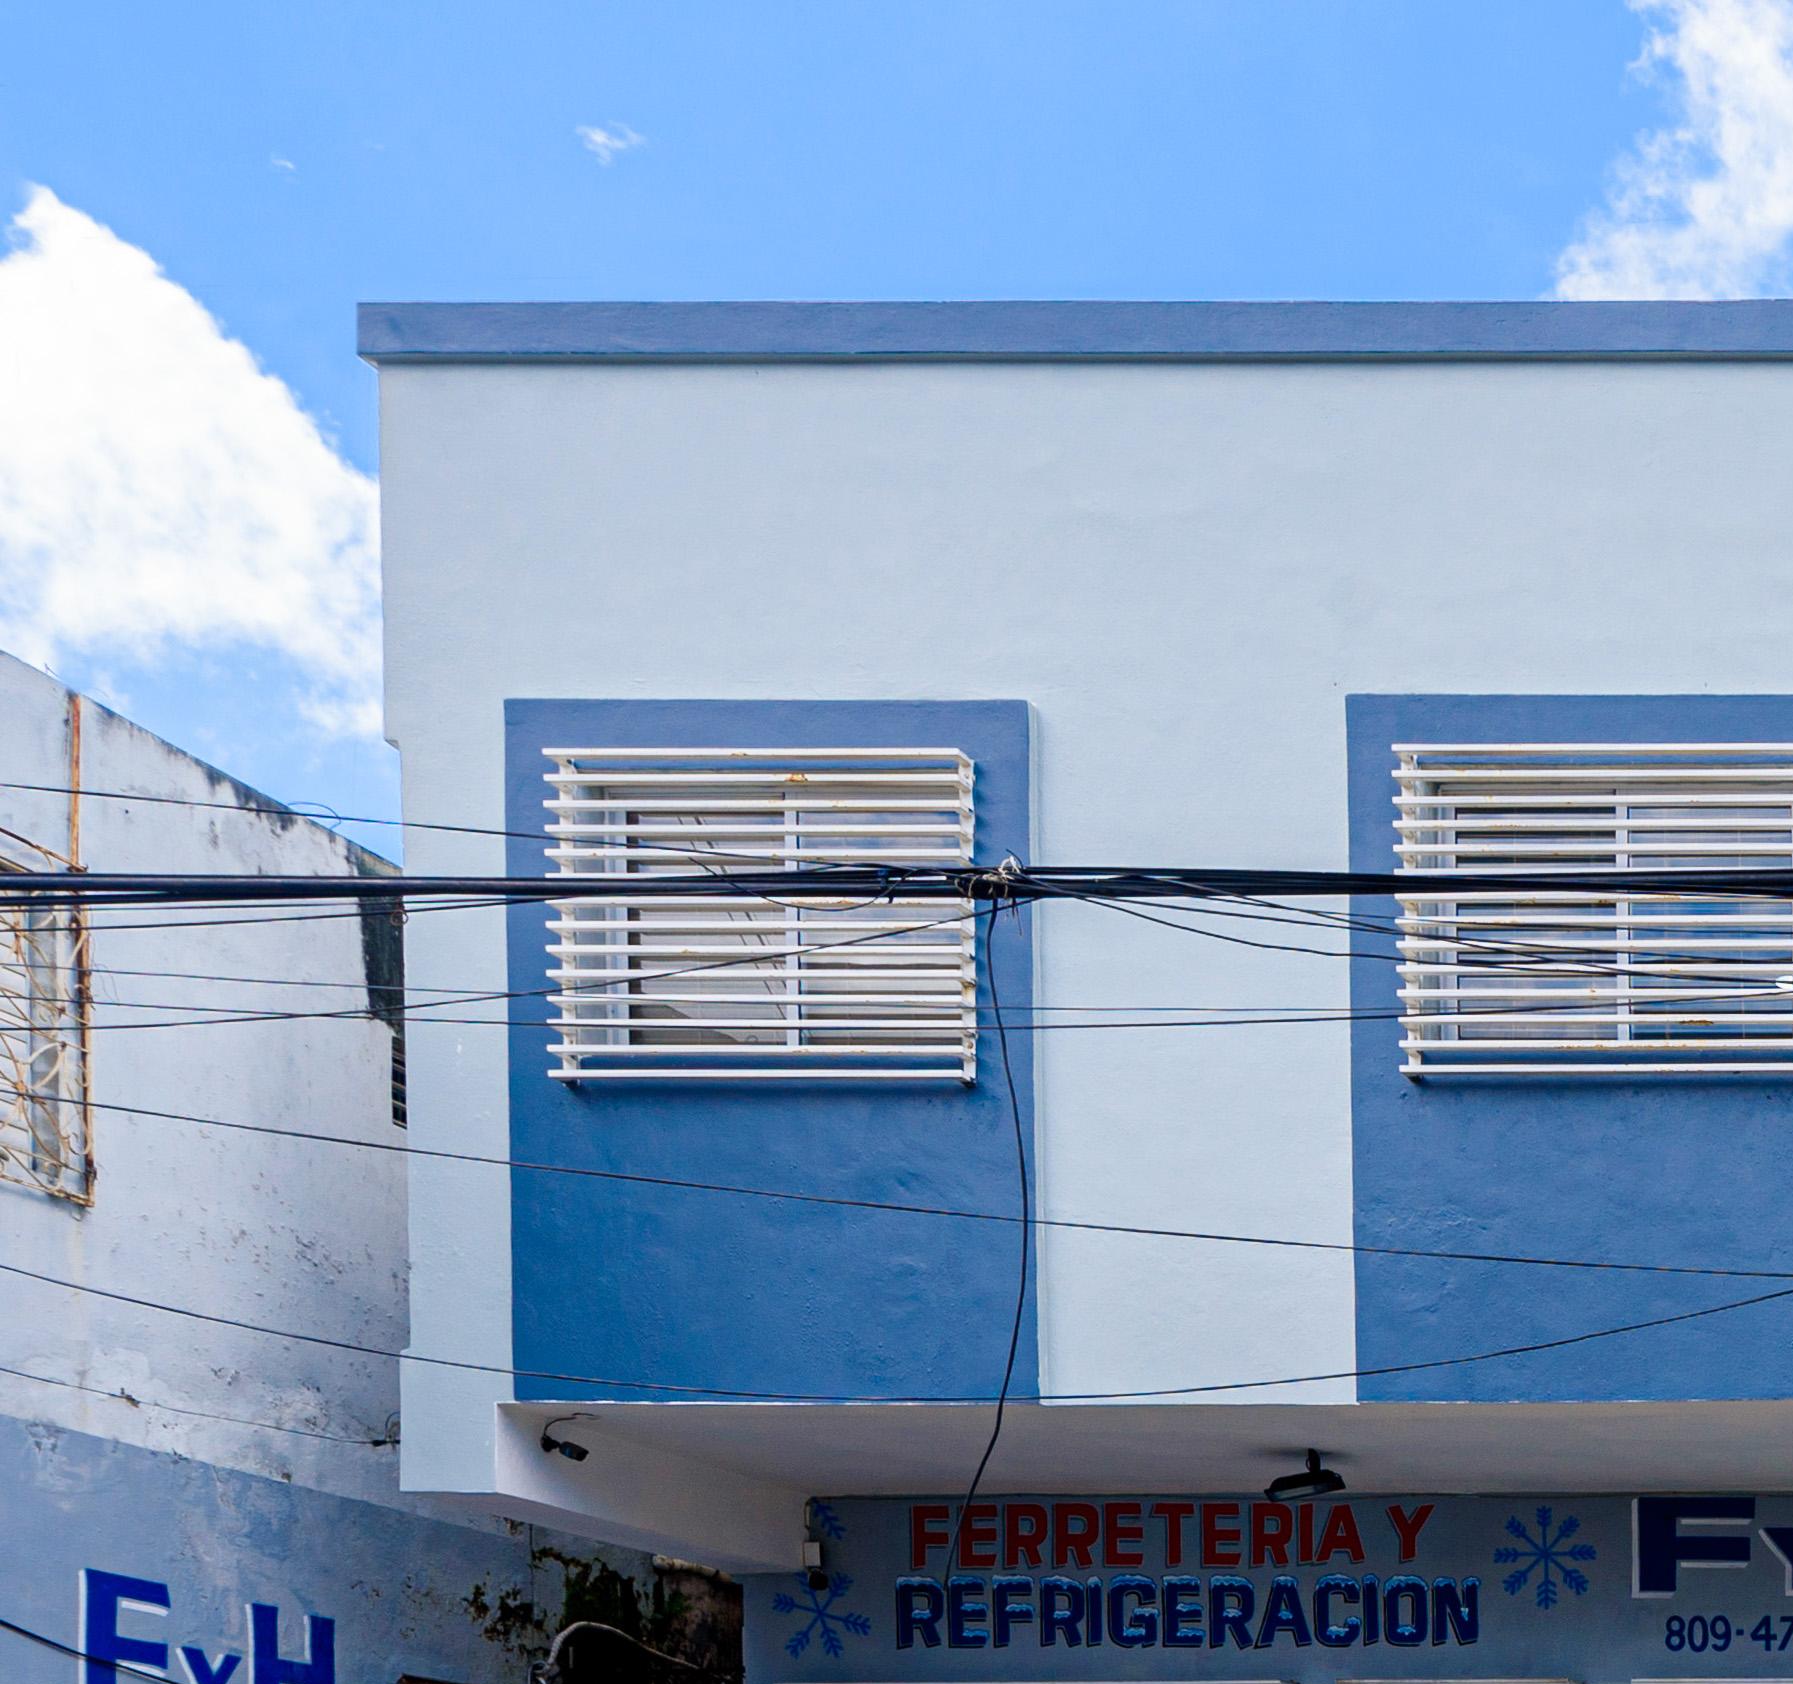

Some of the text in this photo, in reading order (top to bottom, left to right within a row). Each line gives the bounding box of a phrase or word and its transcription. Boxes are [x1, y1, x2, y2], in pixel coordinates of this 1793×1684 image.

[909, 1502, 1435, 1568] FERRETERIA Y
[895, 1573, 1482, 1650] REFRIGERACION
